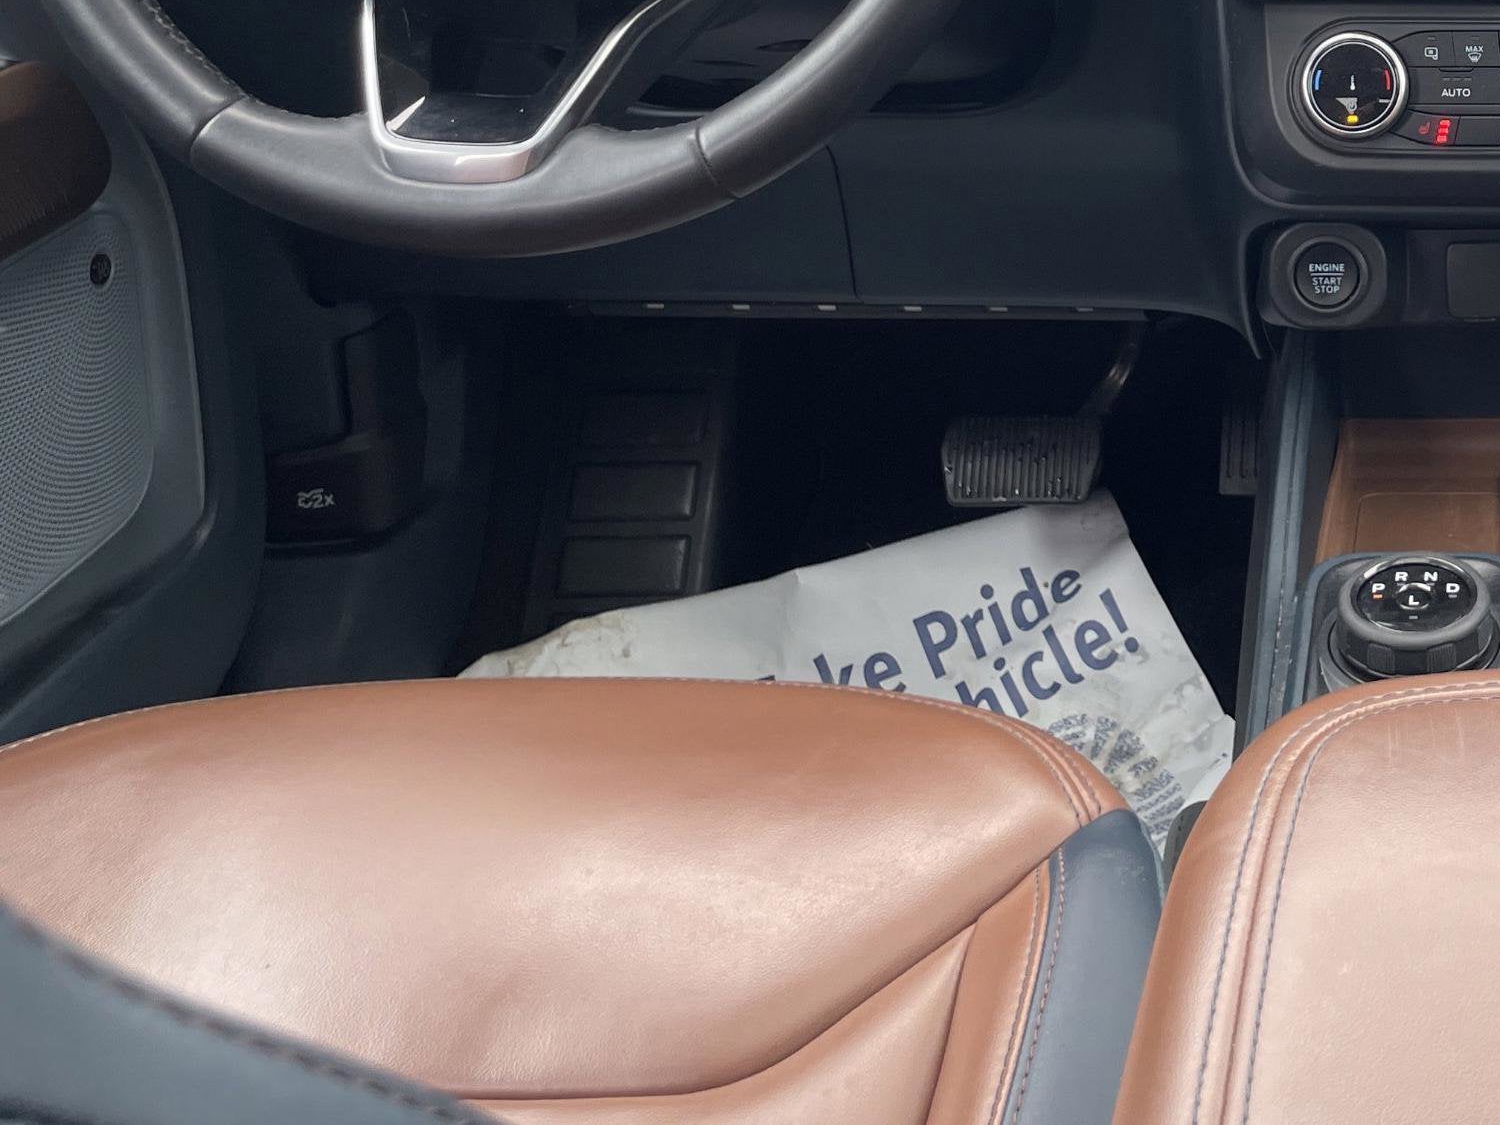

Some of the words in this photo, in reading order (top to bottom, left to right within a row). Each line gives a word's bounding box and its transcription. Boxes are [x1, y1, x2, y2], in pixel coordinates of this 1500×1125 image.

[1465, 45, 1484, 53] MAX
[1441, 88, 1471, 97] AUTO
[1308, 263, 1345, 272] ENGINE
[1312, 276, 1342, 286] START
[1314, 285, 1340, 294] STOP
[1394, 571, 1409, 582] R
[1423, 571, 1439, 582] N
[1371, 583, 1386, 594] P
[1446, 583, 1461, 593] D
[1408, 594, 1420, 606] L
[912, 566, 1082, 680] Pride
[954, 587, 1139, 719] hicle!
